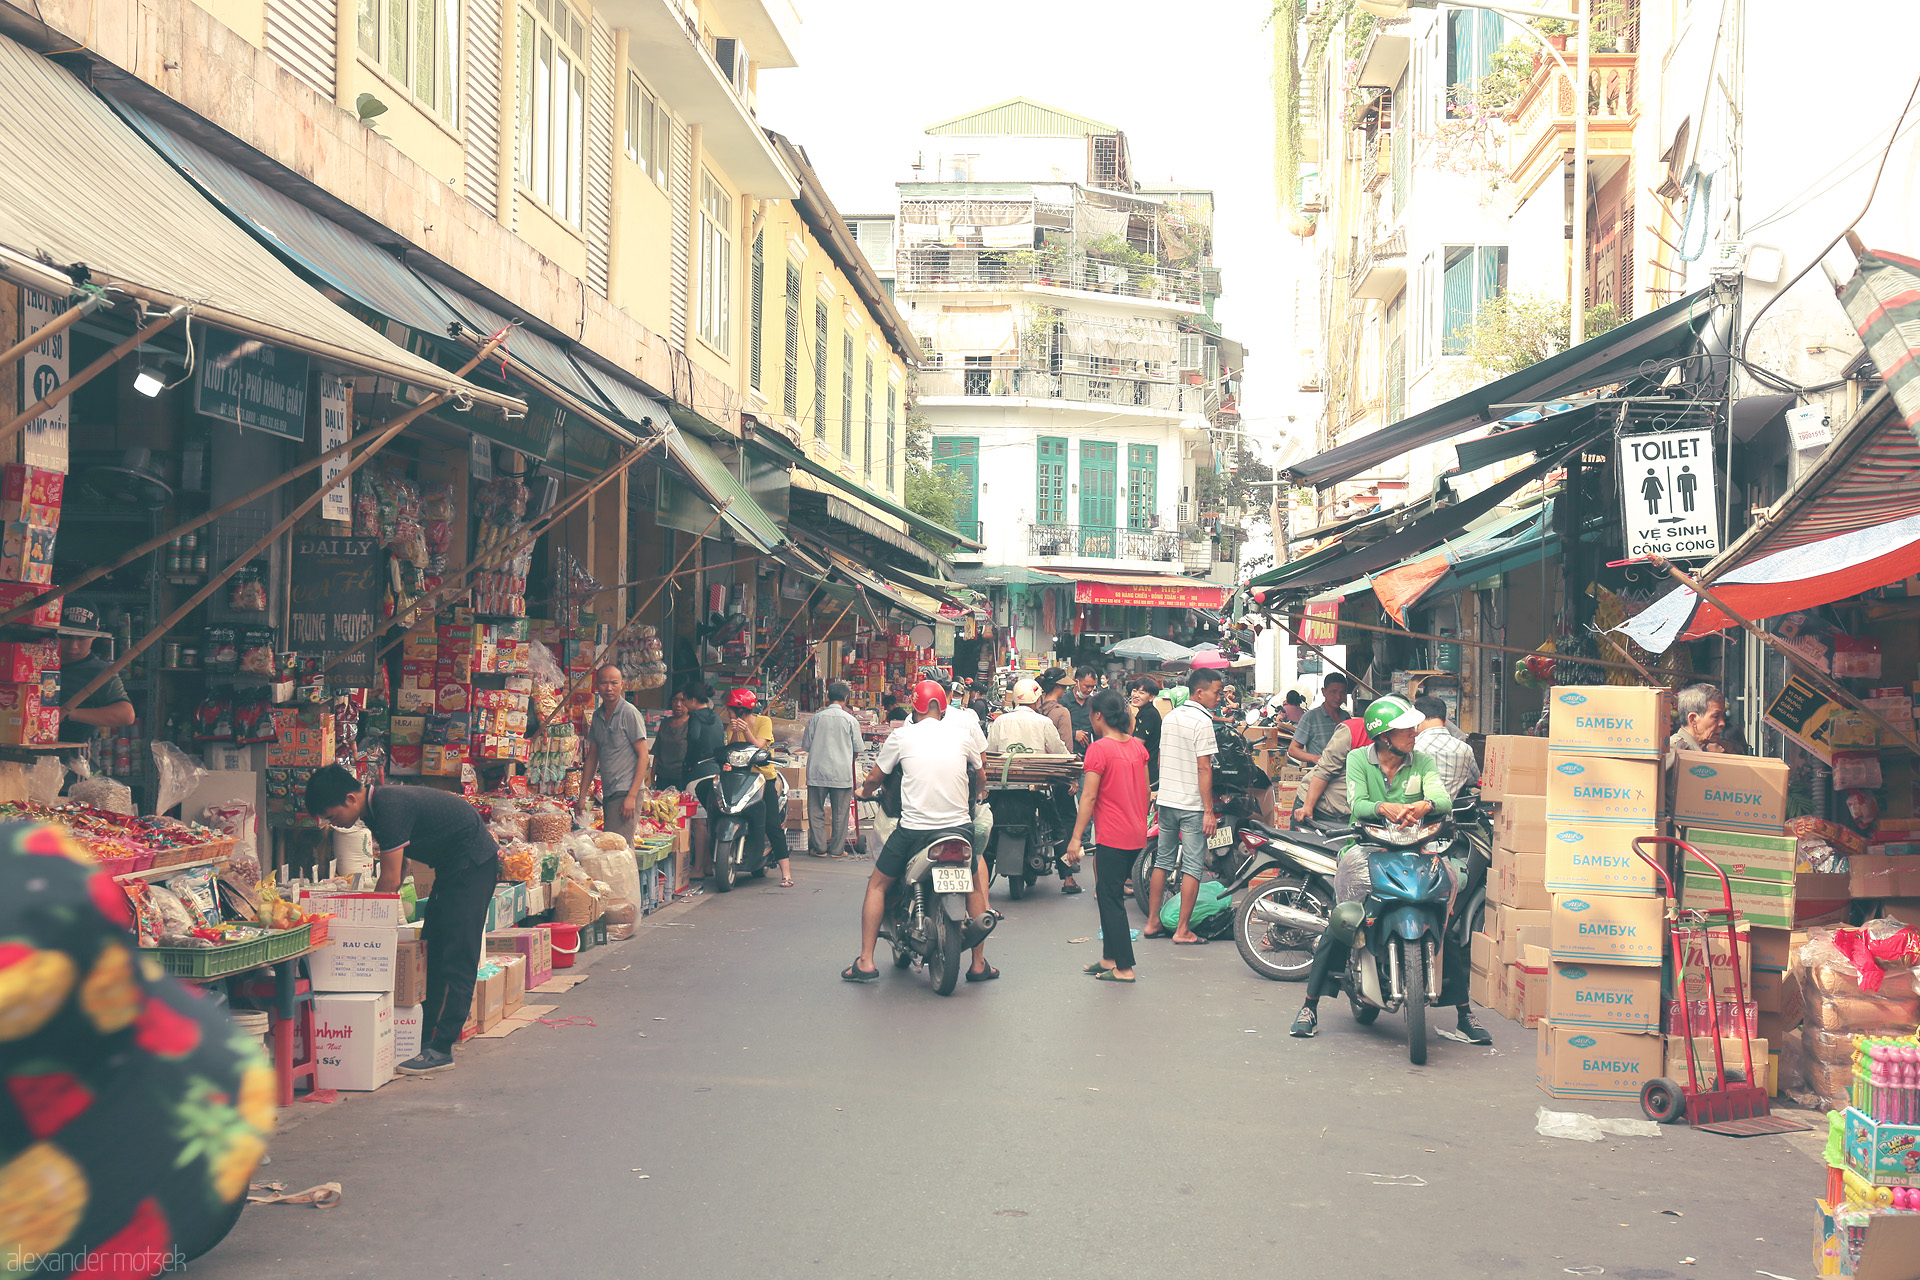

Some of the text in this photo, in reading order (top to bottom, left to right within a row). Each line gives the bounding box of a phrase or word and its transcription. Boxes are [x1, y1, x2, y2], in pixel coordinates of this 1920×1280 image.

[39, 371, 55, 399] 12
[228, 368, 238, 396] 12
[245, 368, 262, 404] PHỐ
[263, 376, 285, 411] HÀNG
[325, 408, 344, 432] ĐẠI LÝ
[1799, 430, 1825, 440] 19001515
[1631, 438, 1700, 462] TOILET
[1638, 525, 1707, 541] VỆ SINH
[300, 538, 373, 557] ĐẠI LÝ
[1632, 539, 1715, 555] CÔNG CỘNG
[1161, 586, 1183, 594] HIỆP
[64, 607, 94, 620] SUPER
[69, 614, 87, 624] RUN
[292, 608, 374, 644] TRUNG NGUYÊN
[447, 629, 466, 637] JAMY
[1366, 718, 1382, 730] Grab
[1576, 717, 1634, 730] БАМБУК
[1574, 786, 1631, 800] БАМБУК
[1704, 789, 1763, 806] БАМБУК
[1208, 836, 1232, 848] 533.80
[1573, 855, 1631, 868] БАМБУК
[937, 881, 970, 890] 295.97
[1579, 923, 1637, 937] БАМБУК
[1576, 991, 1634, 1005] БАМБУК
[323, 1056, 341, 1066] Sấy
[1583, 1059, 1640, 1074] БАМБУК
[1878, 1134, 1916, 1154] Bubble
[1889, 1143, 1915, 1156] CARTOON
